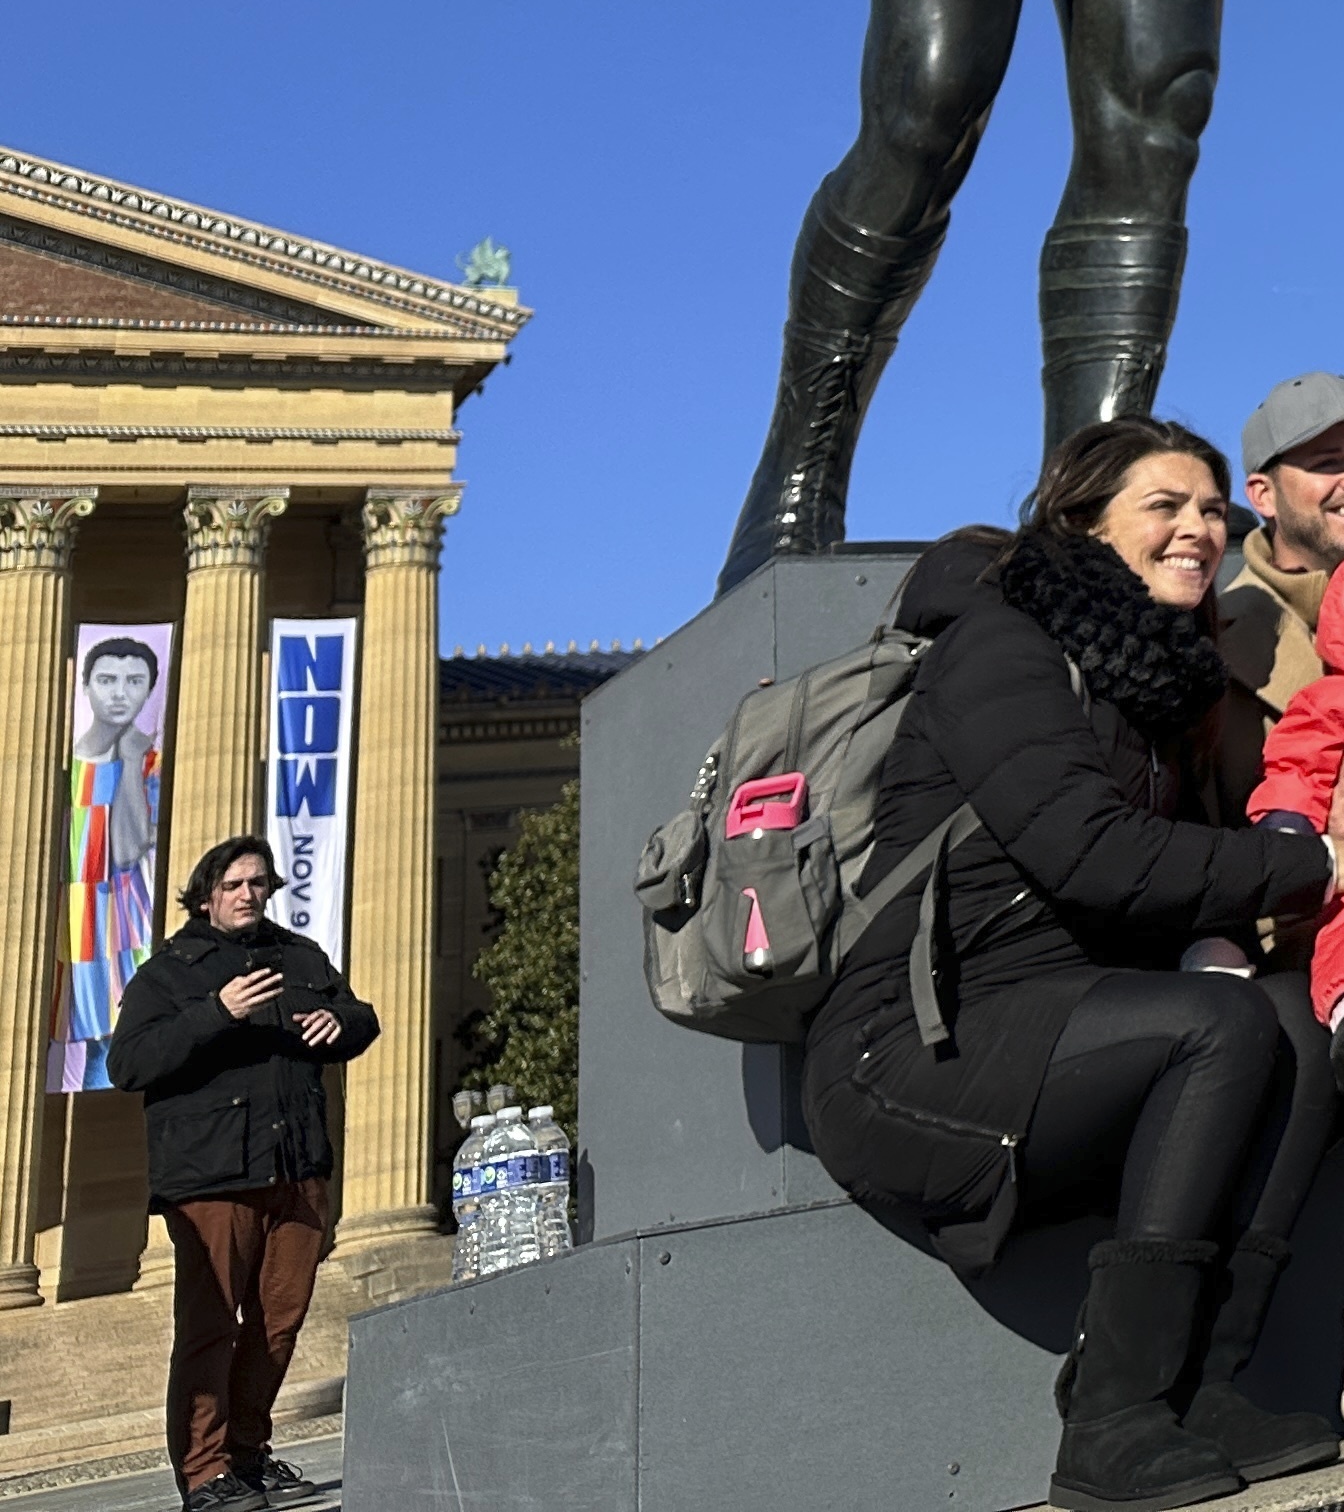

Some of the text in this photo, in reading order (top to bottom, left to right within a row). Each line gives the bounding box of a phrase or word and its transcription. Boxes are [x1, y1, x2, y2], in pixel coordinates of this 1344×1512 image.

[276, 635, 344, 817] NOW
[290, 834, 314, 928] NOV 9
